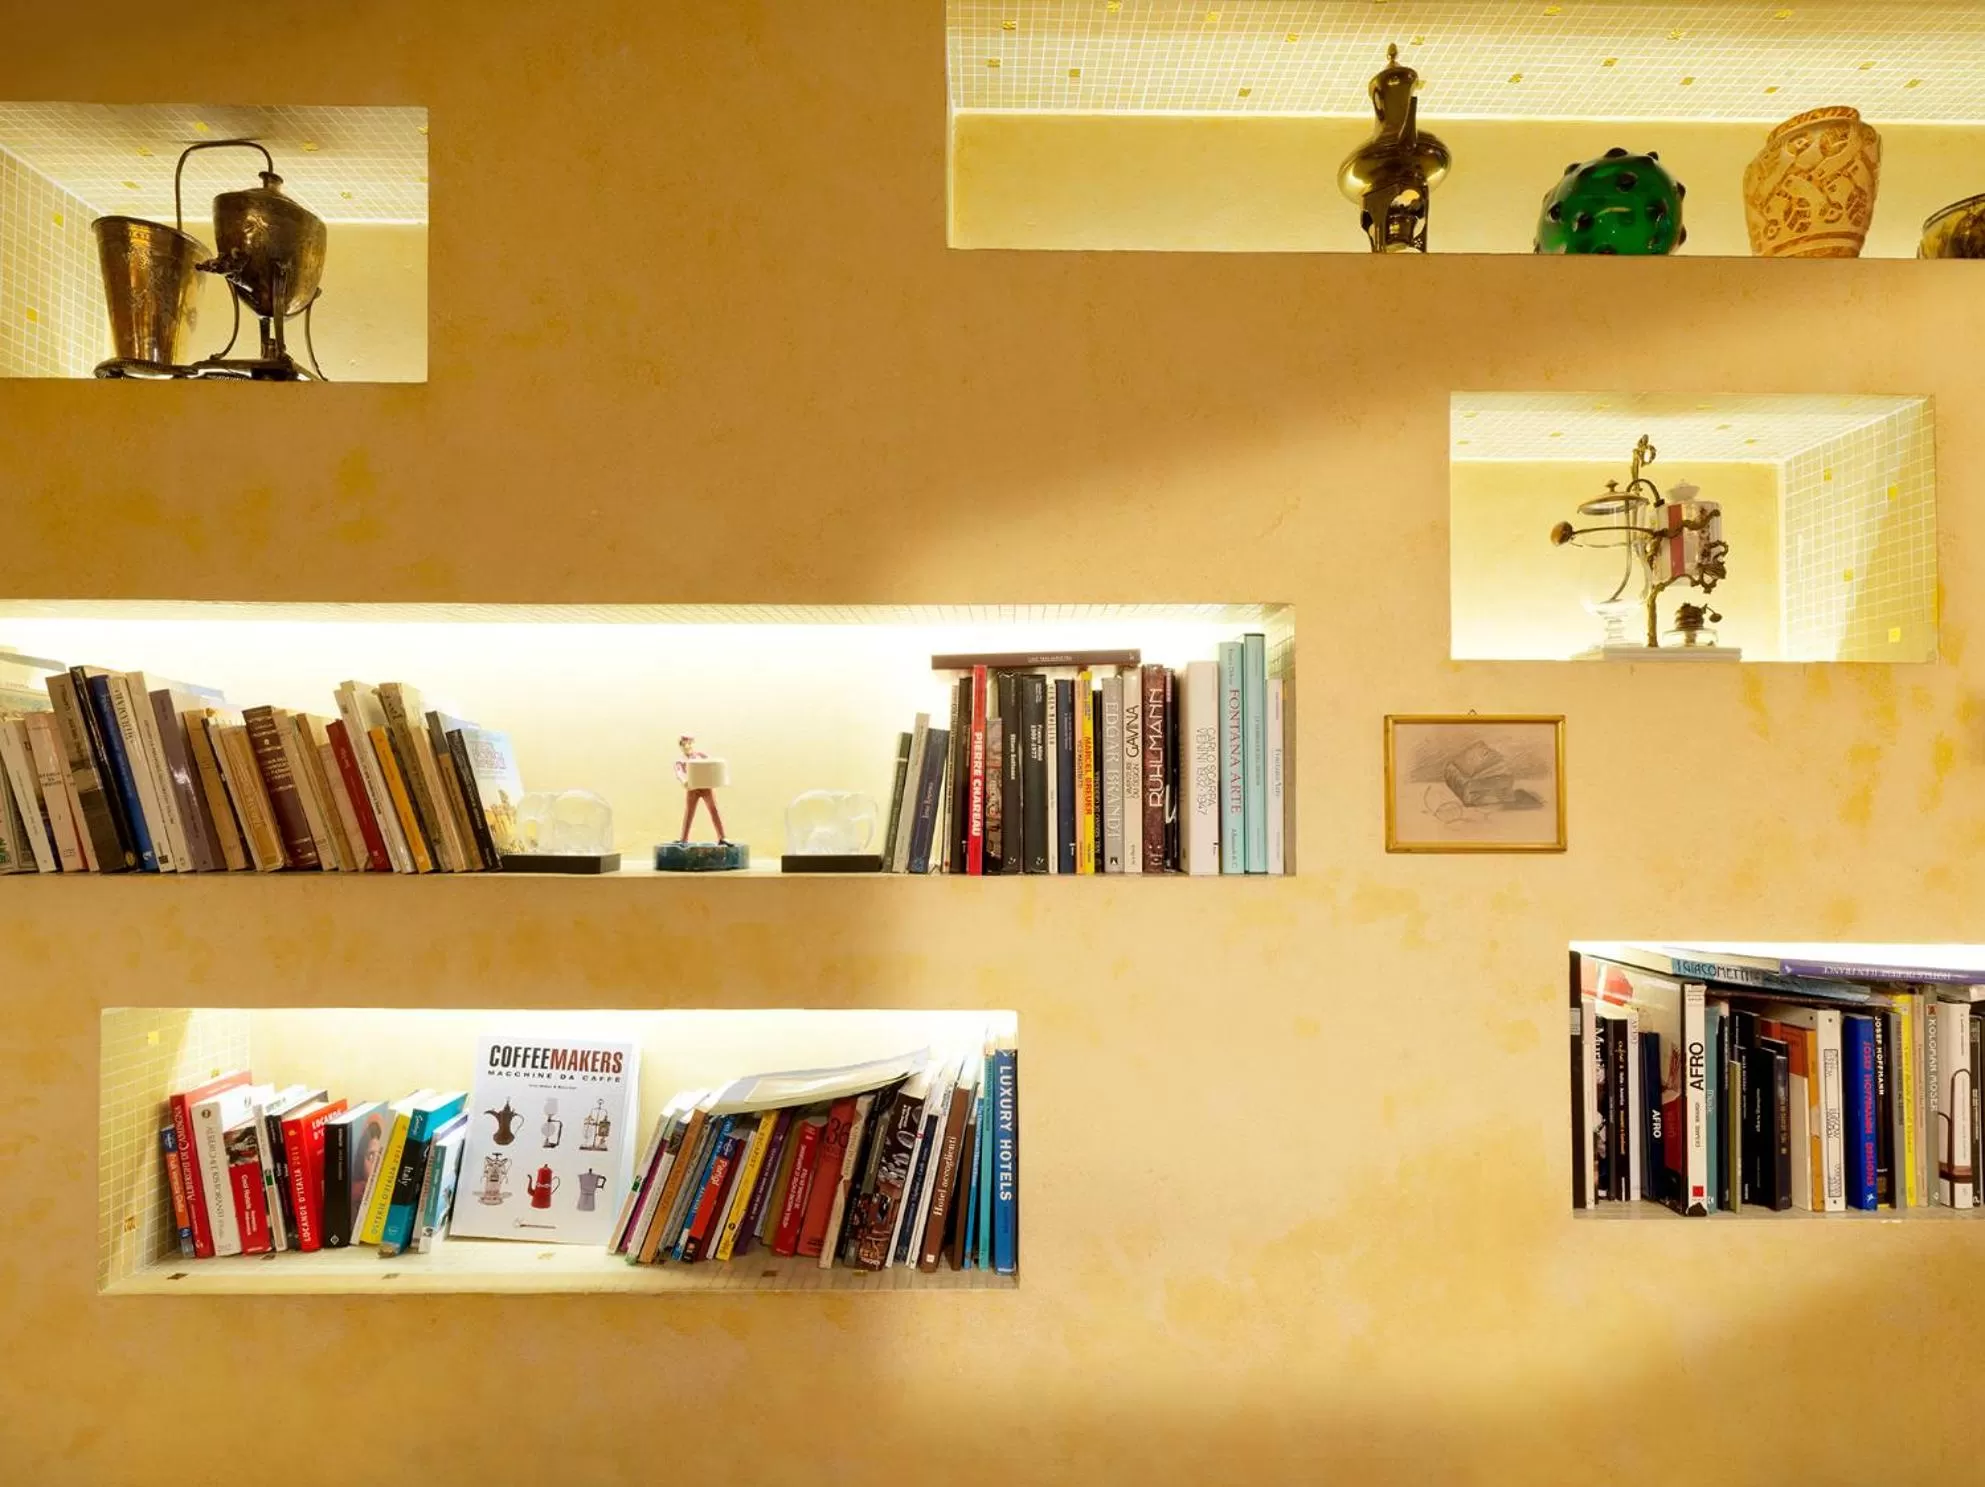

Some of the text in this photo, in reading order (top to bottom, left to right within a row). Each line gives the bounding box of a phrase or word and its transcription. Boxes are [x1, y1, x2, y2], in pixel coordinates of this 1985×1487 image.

[1126, 705, 1139, 757] GAVINA
[1148, 688, 1163, 807] RUHLMANN
[1229, 689, 1241, 767] FONTANA
[1084, 736, 1092, 775] MARCEL
[1105, 702, 1121, 840] EDGAR BRANDT
[972, 732, 983, 837] PIERRE CHAREAU
[1230, 772, 1242, 814] ARTE
[1682, 961, 1753, 982] GIACOMETTI
[487, 1070, 552, 1080] MACCHINE
[489, 1045, 624, 1074] COFFEEMAKERS
[1689, 1042, 1704, 1090] AFRO
[1874, 1016, 1885, 1095] JOSEF HOFFMANN
[1928, 1019, 1938, 1112] KOLOMAN MOSER
[998, 1065, 1013, 1202] LUXURY HOTELS
[1652, 1109, 1661, 1138] AFRO
[241, 1174, 253, 1210] Cool Hotels
[293, 1168, 306, 1203] D'ITALIA
[396, 1164, 415, 1187] Italy
[711, 1160, 728, 1186] Parigi
[932, 1136, 957, 1216] Hotel accoglienti
[299, 1205, 312, 1242] LOCANDE
